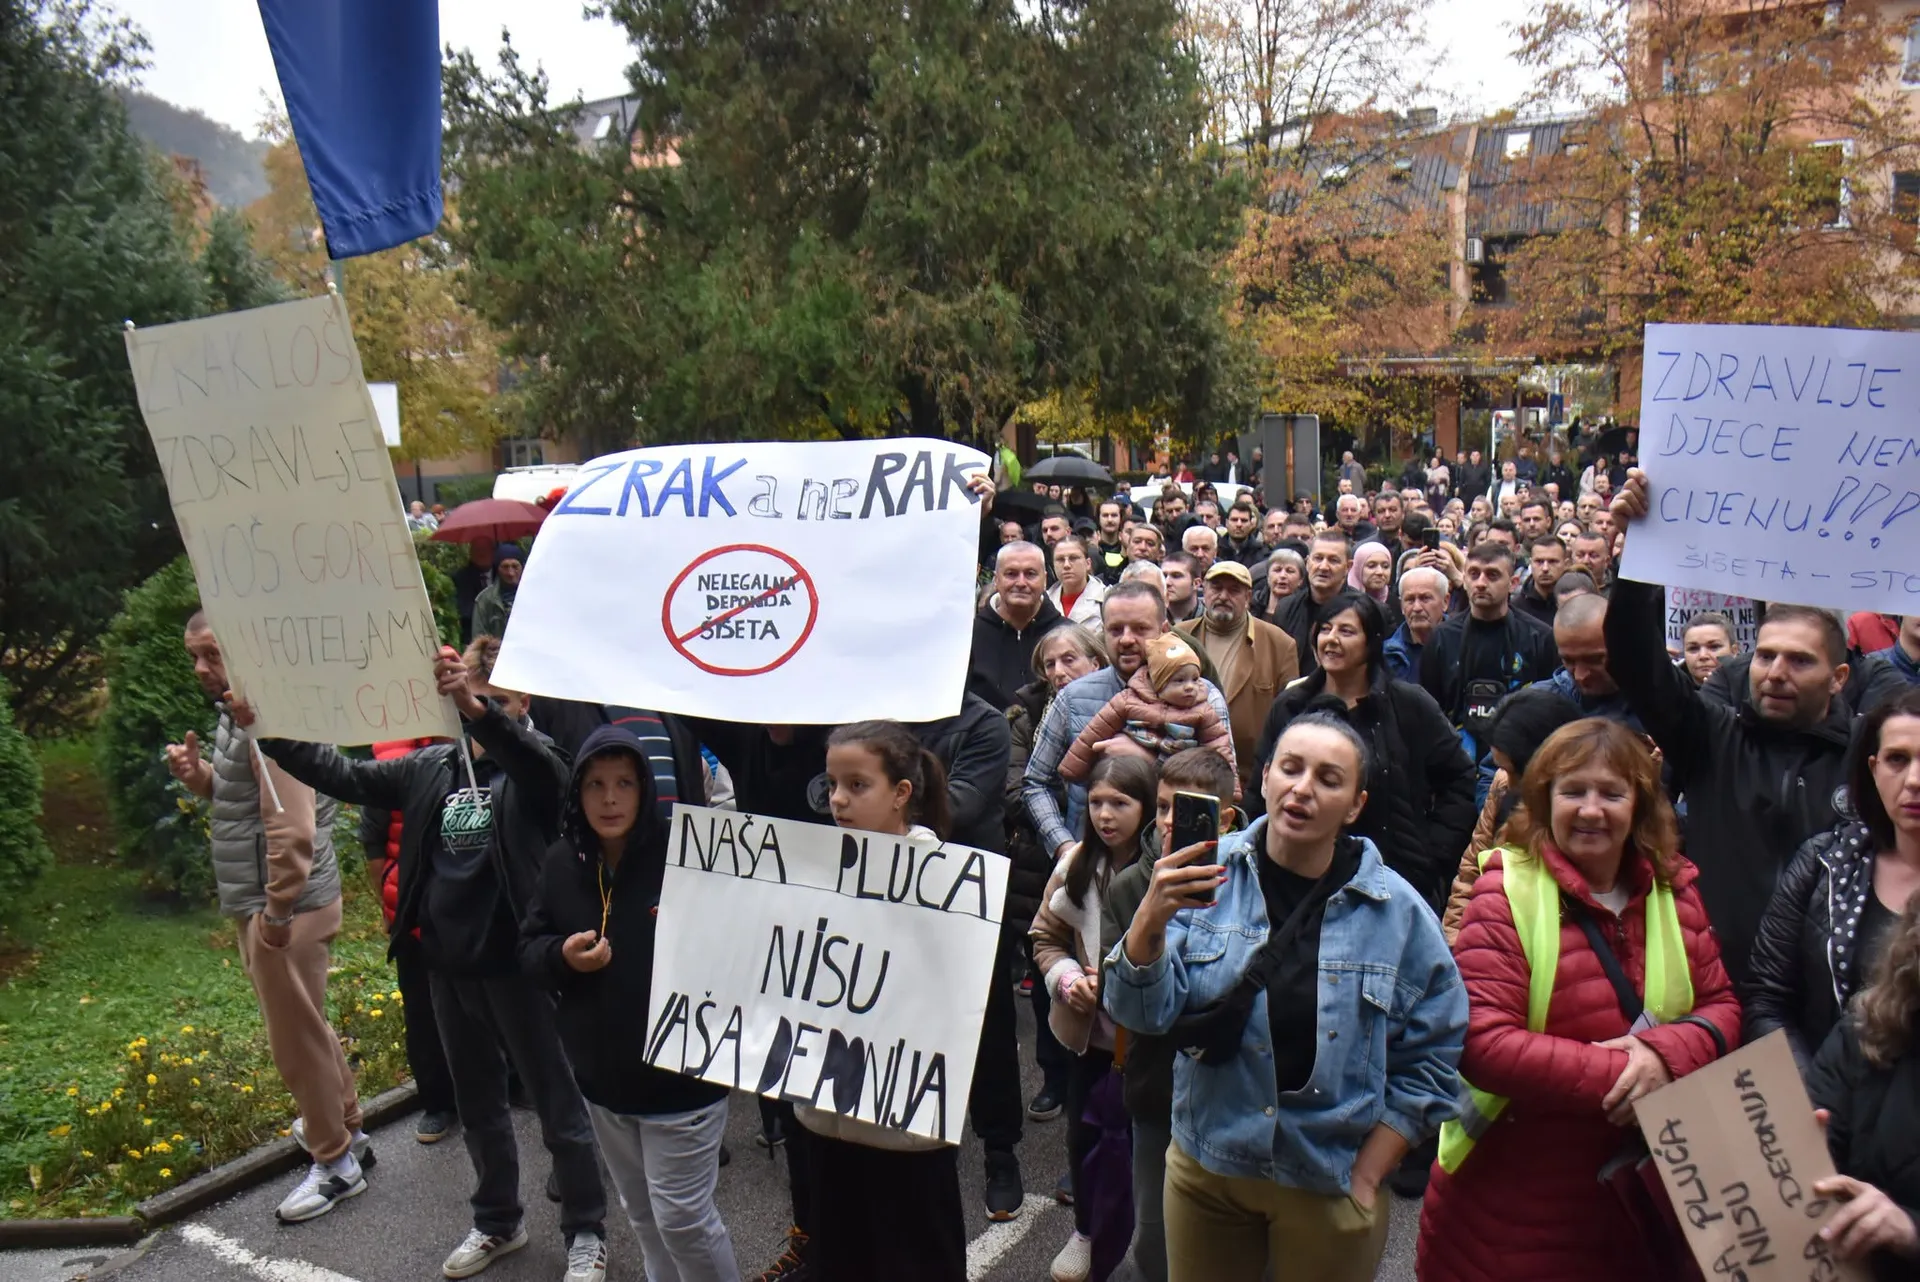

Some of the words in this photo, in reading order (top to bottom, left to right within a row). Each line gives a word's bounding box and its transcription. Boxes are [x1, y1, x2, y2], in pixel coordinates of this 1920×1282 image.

[1652, 351, 1901, 408] ZDRAVLJE
[1659, 412, 1800, 462] DJECE
[558, 456, 748, 518] ZRAK
[747, 474, 784, 519] a
[201, 512, 281, 598] JOŠ
[292, 520, 418, 591] GORE
[697, 573, 796, 591] NELEGALNA
[1676, 543, 1797, 580] ŠIŠETA
[700, 616, 780, 640] ŠIŠETA
[678, 812, 787, 885] NAŠA
[835, 832, 988, 920] PLUĆA
[644, 989, 743, 1089] VAŠA
[755, 1015, 946, 1141] DEPONIJA
[1653, 1117, 1724, 1230] PLUĆA
[1734, 1067, 1803, 1209] DEPONIJA
[1720, 1180, 1777, 1267] NISU
